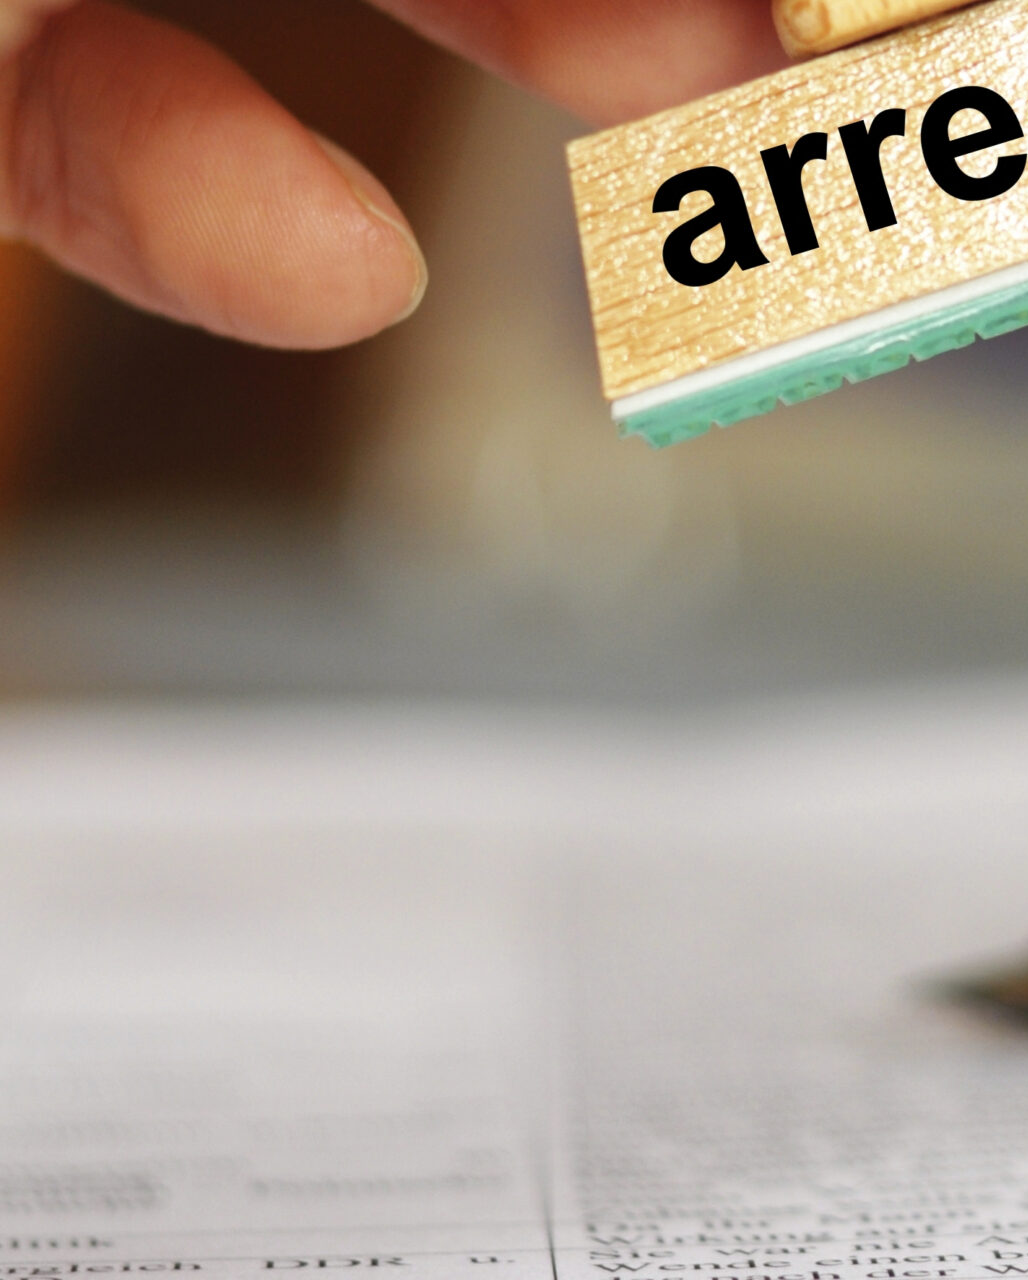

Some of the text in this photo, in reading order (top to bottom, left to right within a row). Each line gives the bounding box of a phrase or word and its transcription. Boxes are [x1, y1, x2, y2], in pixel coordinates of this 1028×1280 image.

[590, 1249, 675, 1261] Sie
[716, 1246, 816, 1256] war
[854, 1238, 934, 1251] nie
[264, 1256, 410, 1270] DDR
[594, 1260, 791, 1273] Wende
[815, 1254, 965, 1267] einen
[868, 1269, 955, 1279] der
